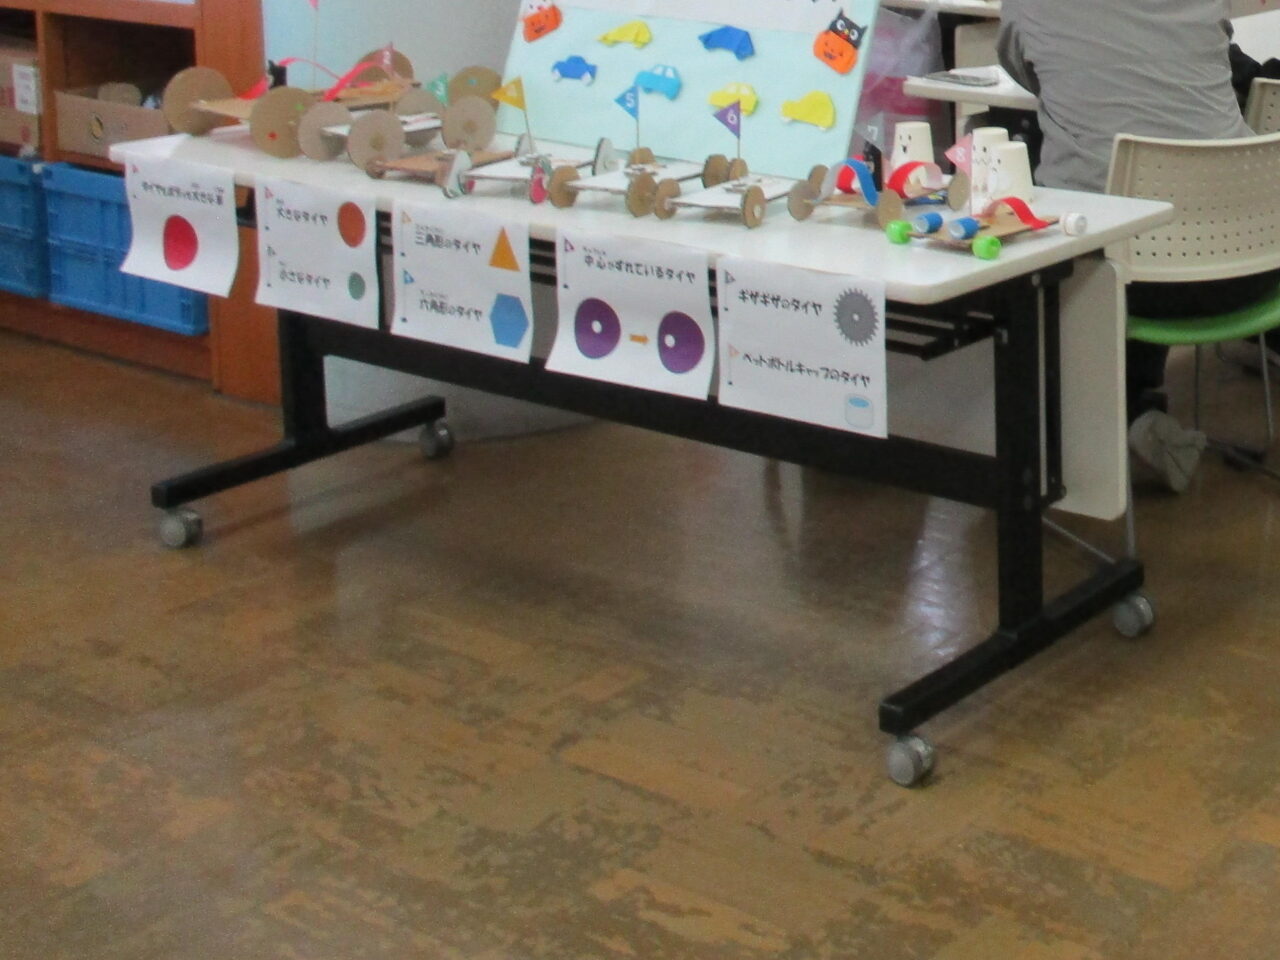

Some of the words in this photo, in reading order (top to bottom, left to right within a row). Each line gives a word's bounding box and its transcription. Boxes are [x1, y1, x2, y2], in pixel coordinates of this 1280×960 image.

[726, 109, 738, 126] 6
[866, 124, 879, 141] 7
[738, 289, 823, 316] ギザギザのタイヤ
